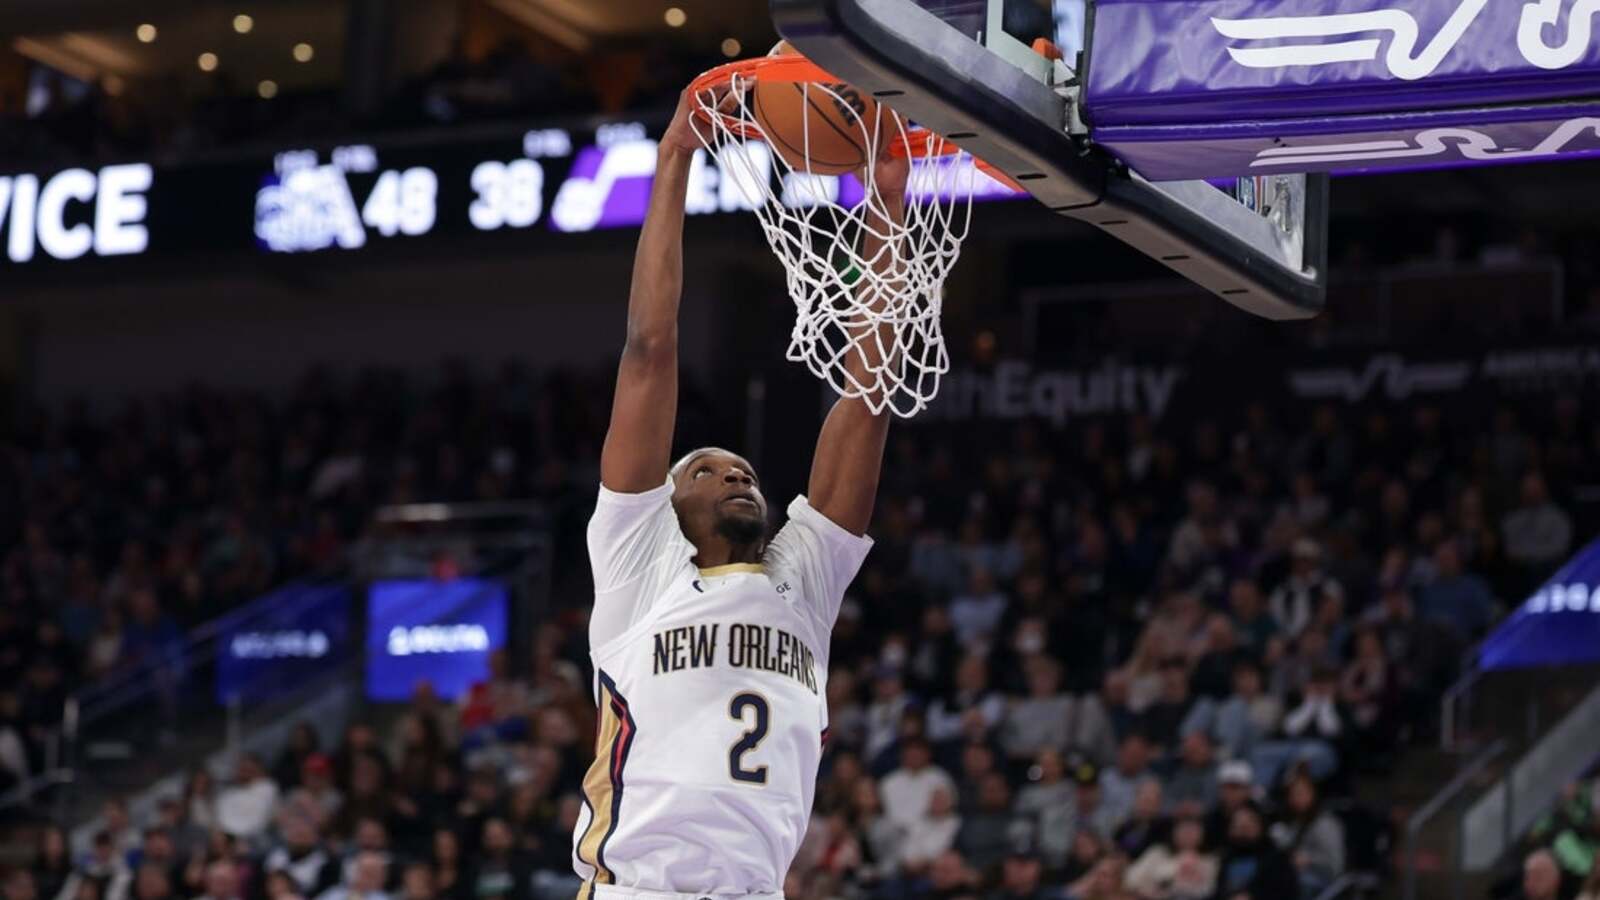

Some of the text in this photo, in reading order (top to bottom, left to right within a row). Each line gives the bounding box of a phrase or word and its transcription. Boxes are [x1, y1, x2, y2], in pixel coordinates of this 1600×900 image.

[363, 167, 438, 235] 48
[653, 623, 818, 696] NEW ORLEANS
[728, 692, 771, 785] 2
